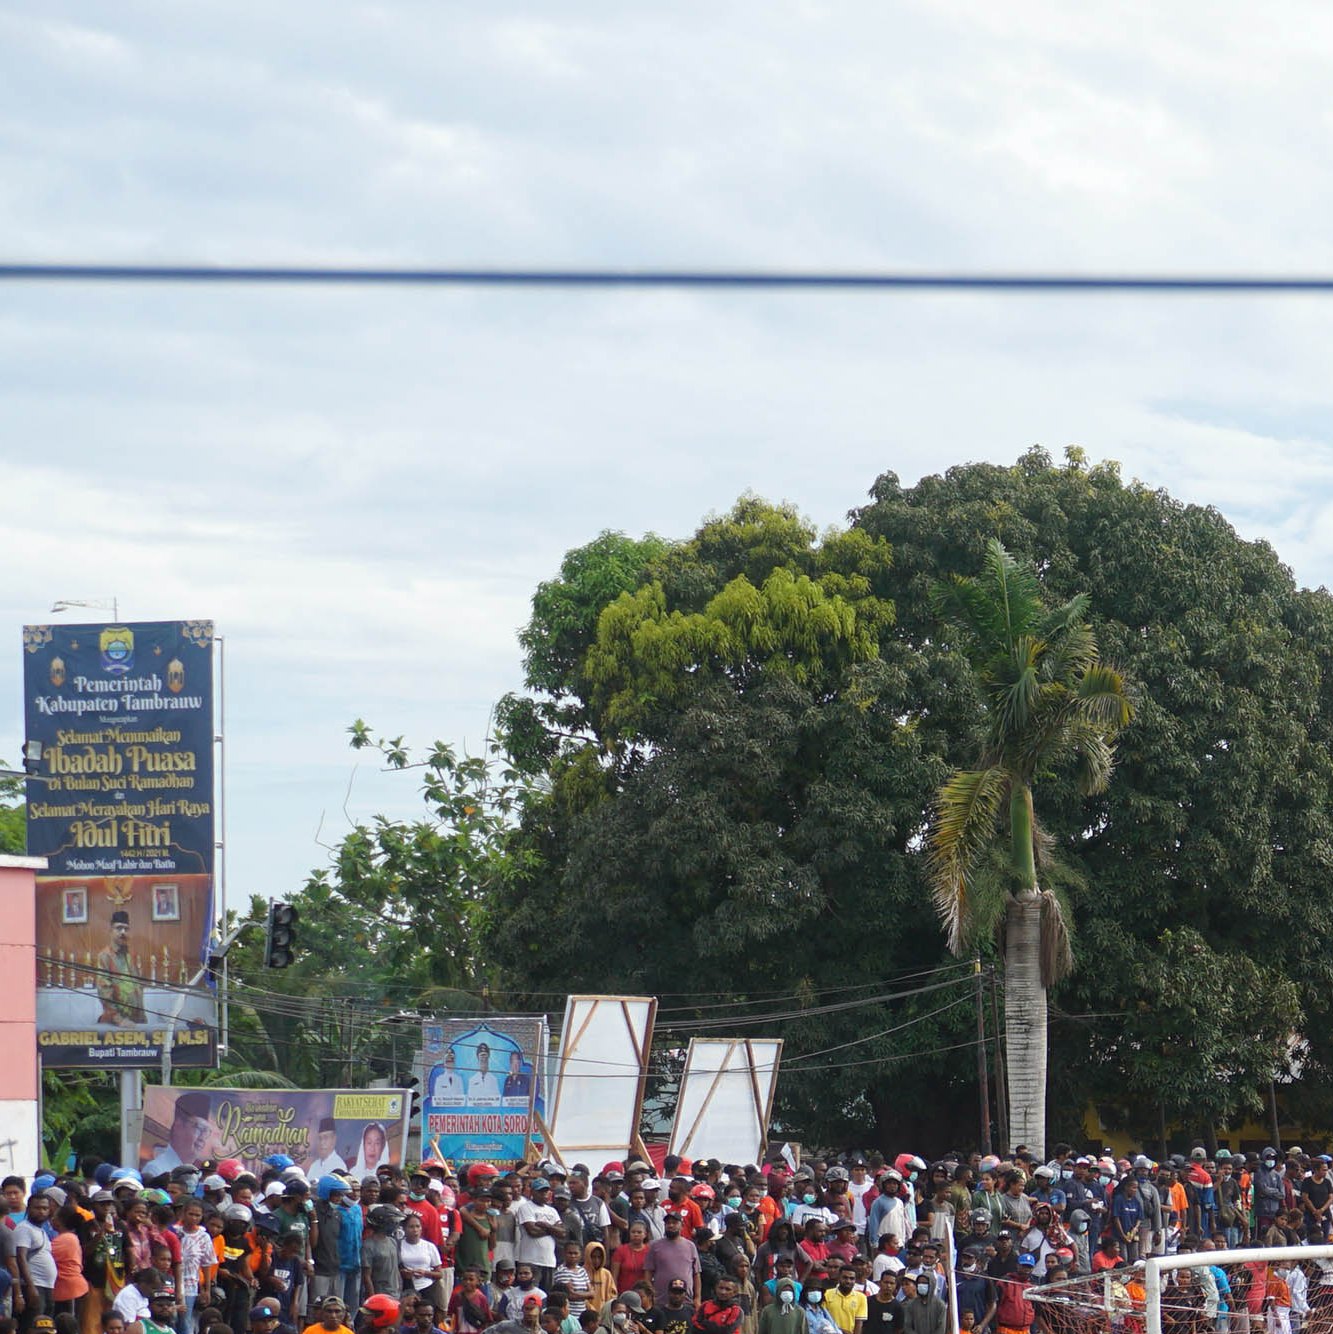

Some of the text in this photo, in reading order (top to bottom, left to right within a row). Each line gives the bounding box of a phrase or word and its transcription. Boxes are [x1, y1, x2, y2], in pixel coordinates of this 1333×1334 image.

[73, 673, 163, 694] Pemerintah
[35, 693, 203, 716] Kabupaten Tambrauw
[56, 728, 105, 747] Selamat
[43, 745, 197, 776] Ibadah Puasa
[62, 775, 100, 791] Bulan
[101, 775, 128, 791] Suci
[128, 773, 195, 791] Ramadhan
[29, 797, 211, 820] Selamat Merayakan Hari Raya
[70, 819, 172, 848] Idul Fitri
[38, 1031, 102, 1046] GABRIEL
[104, 1031, 150, 1048] ASEM,
[88, 1047, 158, 1060] Bupati Tambrauw
[215, 1099, 311, 1150] Ramadhan
[429, 1115, 480, 1133] PEMERINTAH
[482, 1115, 502, 1133] KOTA
